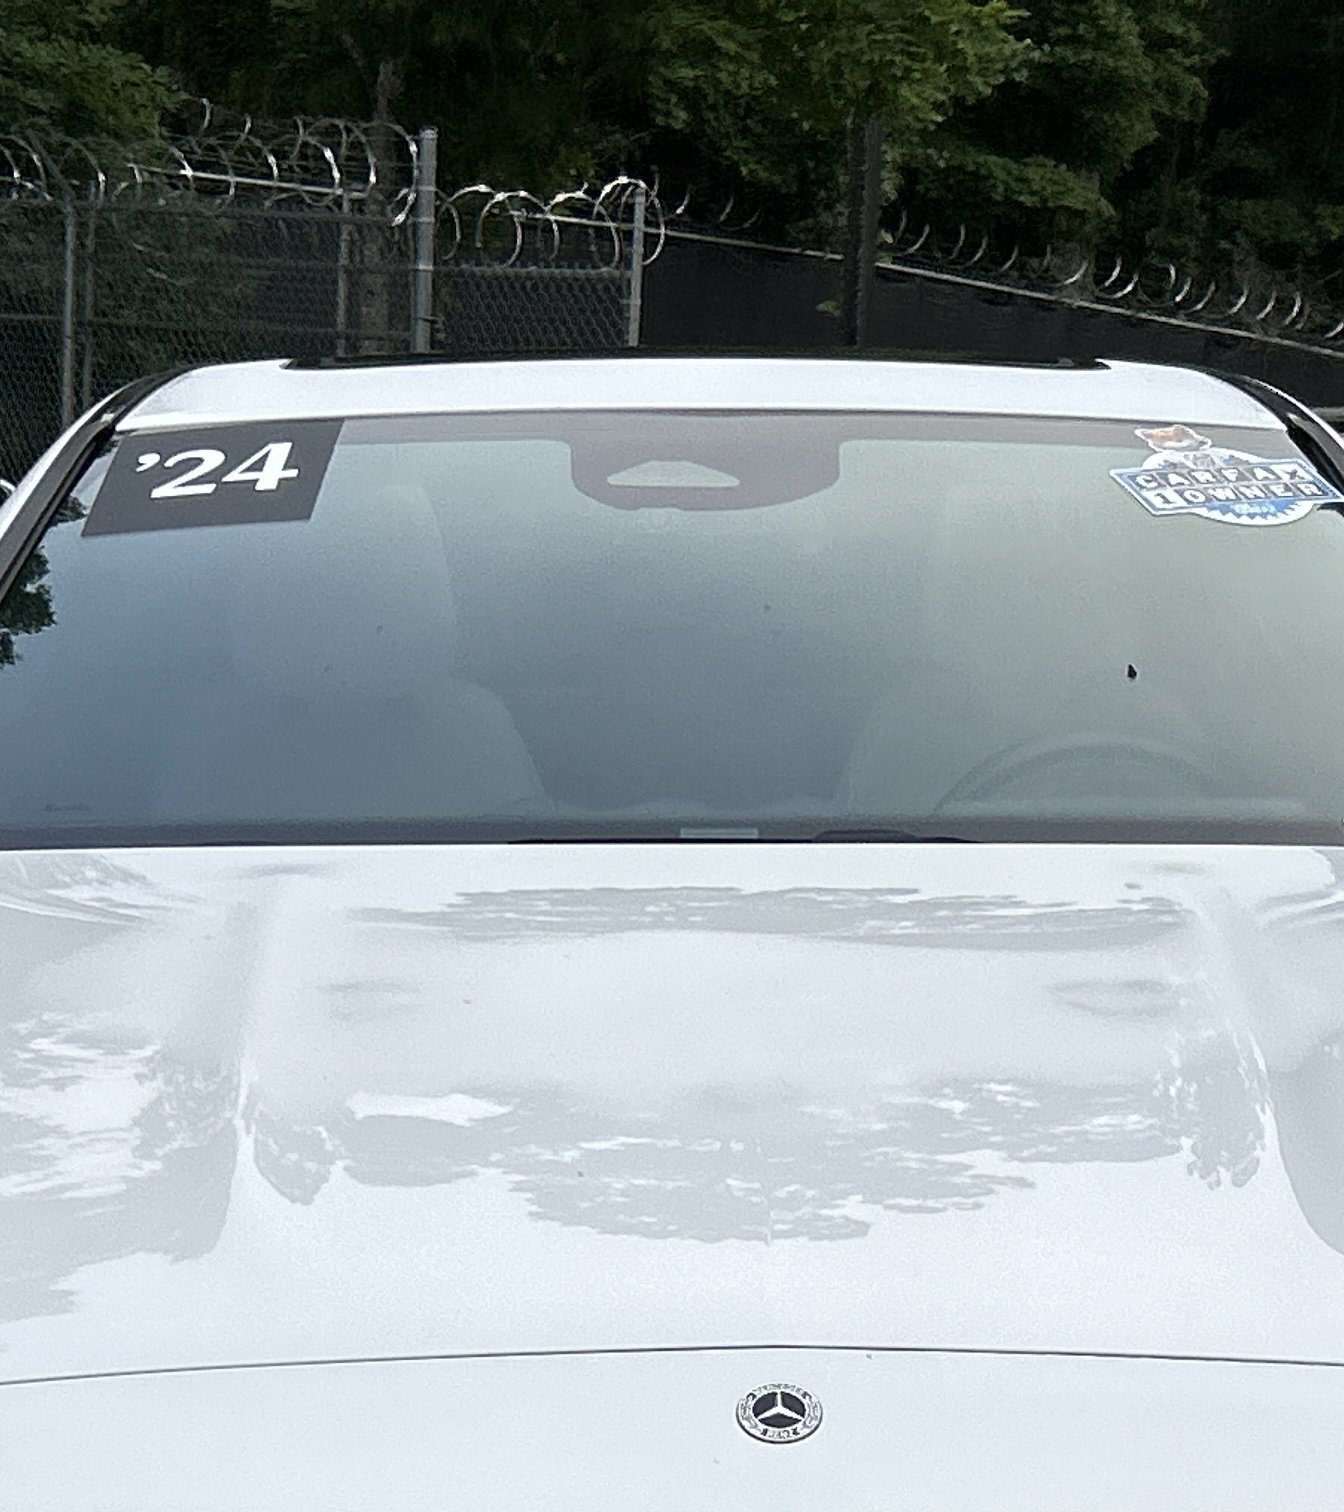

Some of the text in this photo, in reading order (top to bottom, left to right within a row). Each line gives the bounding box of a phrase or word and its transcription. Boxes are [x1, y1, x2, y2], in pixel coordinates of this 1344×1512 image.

[135, 442, 299, 499] '24
[1135, 466, 1306, 489] CARFAX
[1154, 482, 1323, 505] 1 OWNER
